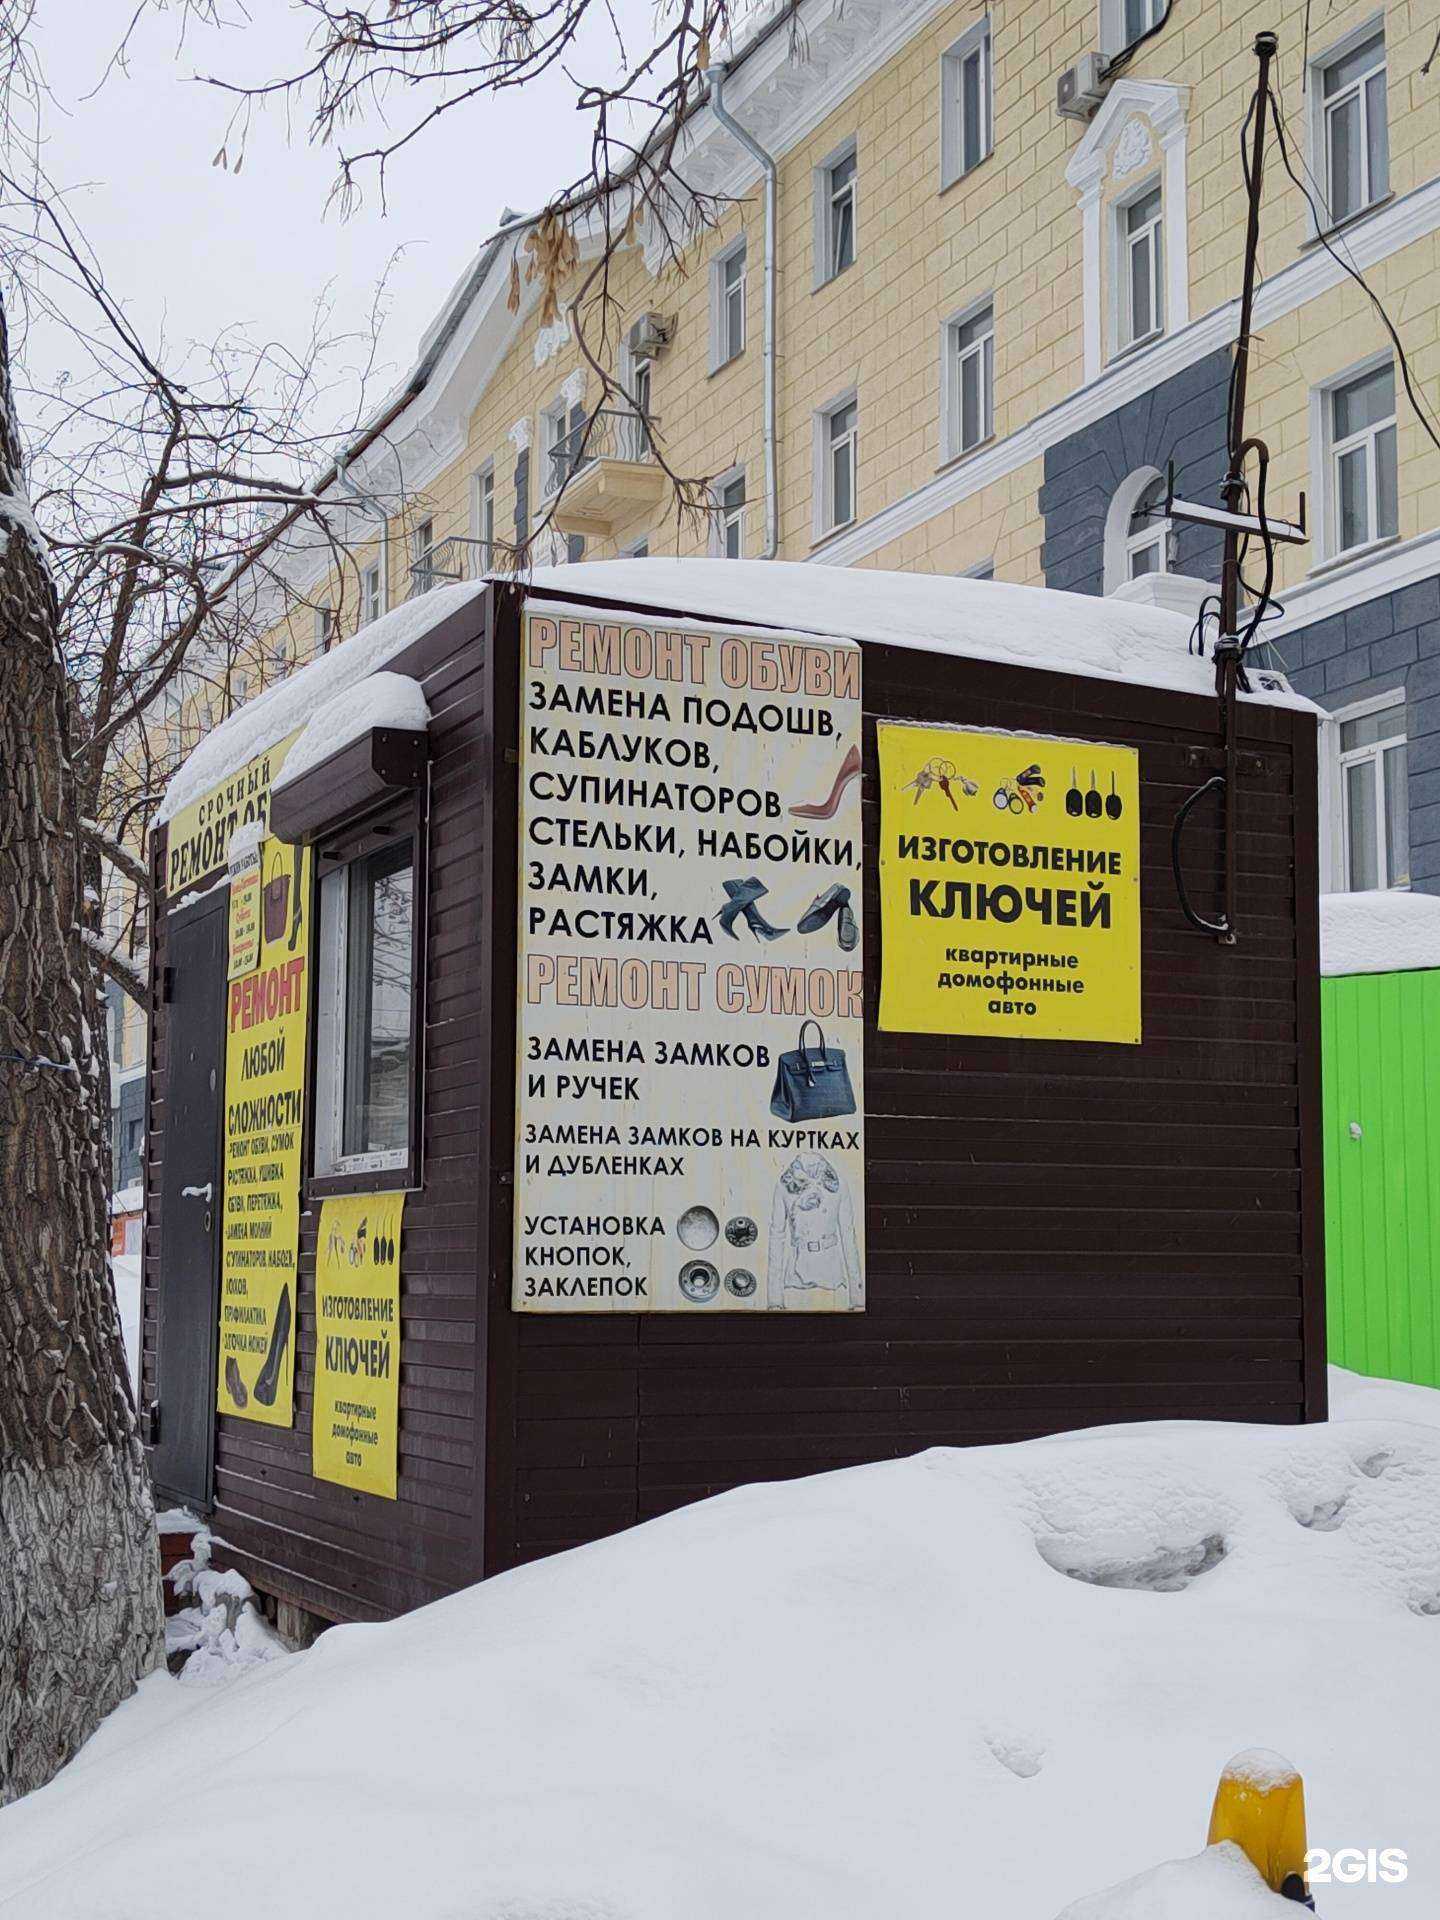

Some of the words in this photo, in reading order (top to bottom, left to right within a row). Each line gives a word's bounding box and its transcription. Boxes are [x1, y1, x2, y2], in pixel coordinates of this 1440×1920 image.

[529, 617, 710, 684] РЕМОНТ
[720, 638, 861, 700] ОБУВИ
[529, 681, 671, 721] ЗАМЕНА
[683, 696, 843, 741] ПОДОШВ,
[531, 726, 719, 774] КАБЛУКОВ,
[199, 757, 270, 826] СРОЧНЫЙ
[529, 771, 781, 818] СУПИНАТОРОВ
[170, 809, 238, 891] РЕМОНТ
[529, 816, 685, 859] СТЕЛЬКИ,
[698, 829, 862, 871] НАБОЙКИ,
[898, 834, 1122, 875] ИЗГОТОВЛЕНИЕ
[528, 861, 657, 900] ЗАМКИ,
[910, 879, 1111, 929] КЛЮЧЕЙ
[529, 907, 713, 944] РАСТЯЖКА
[945, 947, 1079, 972] квартирные
[231, 956, 305, 1033] РЕМОНТ
[527, 954, 706, 1011] РЕМОНТ
[716, 963, 864, 1018] СУМОК
[938, 971, 1084, 995] домофонные
[988, 1000, 1037, 1015] авто
[241, 1026, 285, 1081] ЛЮБОЙ
[527, 1037, 645, 1064] ЗАМЕНА
[654, 1041, 770, 1068] ЗАМКОВ
[528, 1074, 545, 1098] И
[557, 1075, 640, 1101] РУЧЕК
[229, 1089, 301, 1136] СЛОЖНОСТИ
[271, 1132, 294, 1152] СУМОК
[525, 1124, 620, 1145] ЗАМЕНА
[628, 1126, 723, 1147] ЗАМКОВ
[731, 1129, 761, 1148] НА
[768, 1130, 860, 1150] КУРТКАХ
[526, 1155, 540, 1174] И
[548, 1156, 685, 1177] ДУБЛЕНКАХ
[524, 1216, 665, 1236] УСТАНОВКА
[525, 1247, 631, 1268] КНОПОК,
[524, 1277, 648, 1297] ЗАКЛЕПОК
[322, 1295, 394, 1322] ИЗГОТОВЛЕНИЕ
[326, 1329, 390, 1379] КЛЮЧЕЙ
[335, 1400, 377, 1423] квартирные
[332, 1422, 379, 1446] домофонные
[346, 1451, 362, 1467] авто
